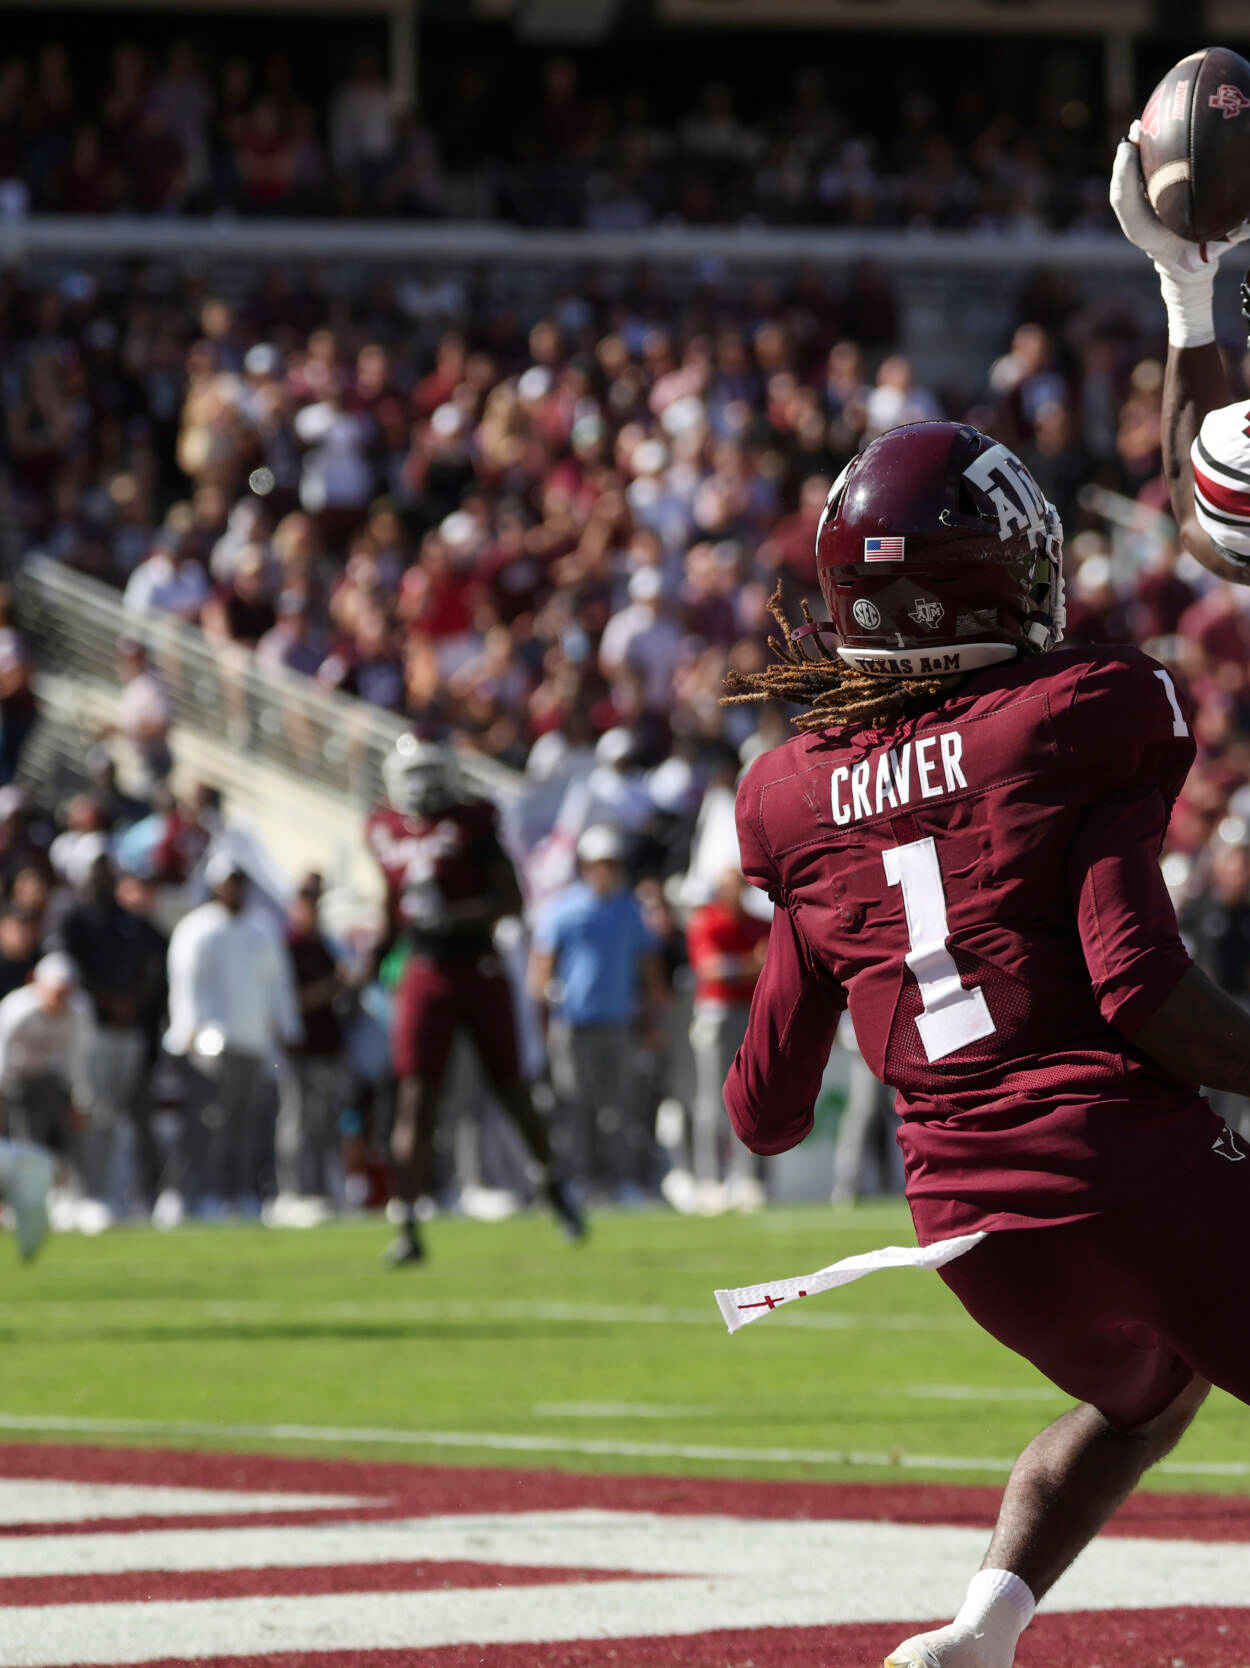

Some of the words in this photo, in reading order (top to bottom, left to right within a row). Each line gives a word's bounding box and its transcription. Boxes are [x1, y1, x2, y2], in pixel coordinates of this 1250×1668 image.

[855, 601, 879, 628] SEC
[855, 657, 913, 674] TEXAS
[920, 653, 960, 672] A&M
[1153, 669, 1189, 737] 1
[830, 730, 968, 825] CRAVER
[882, 836, 997, 1062] 1
